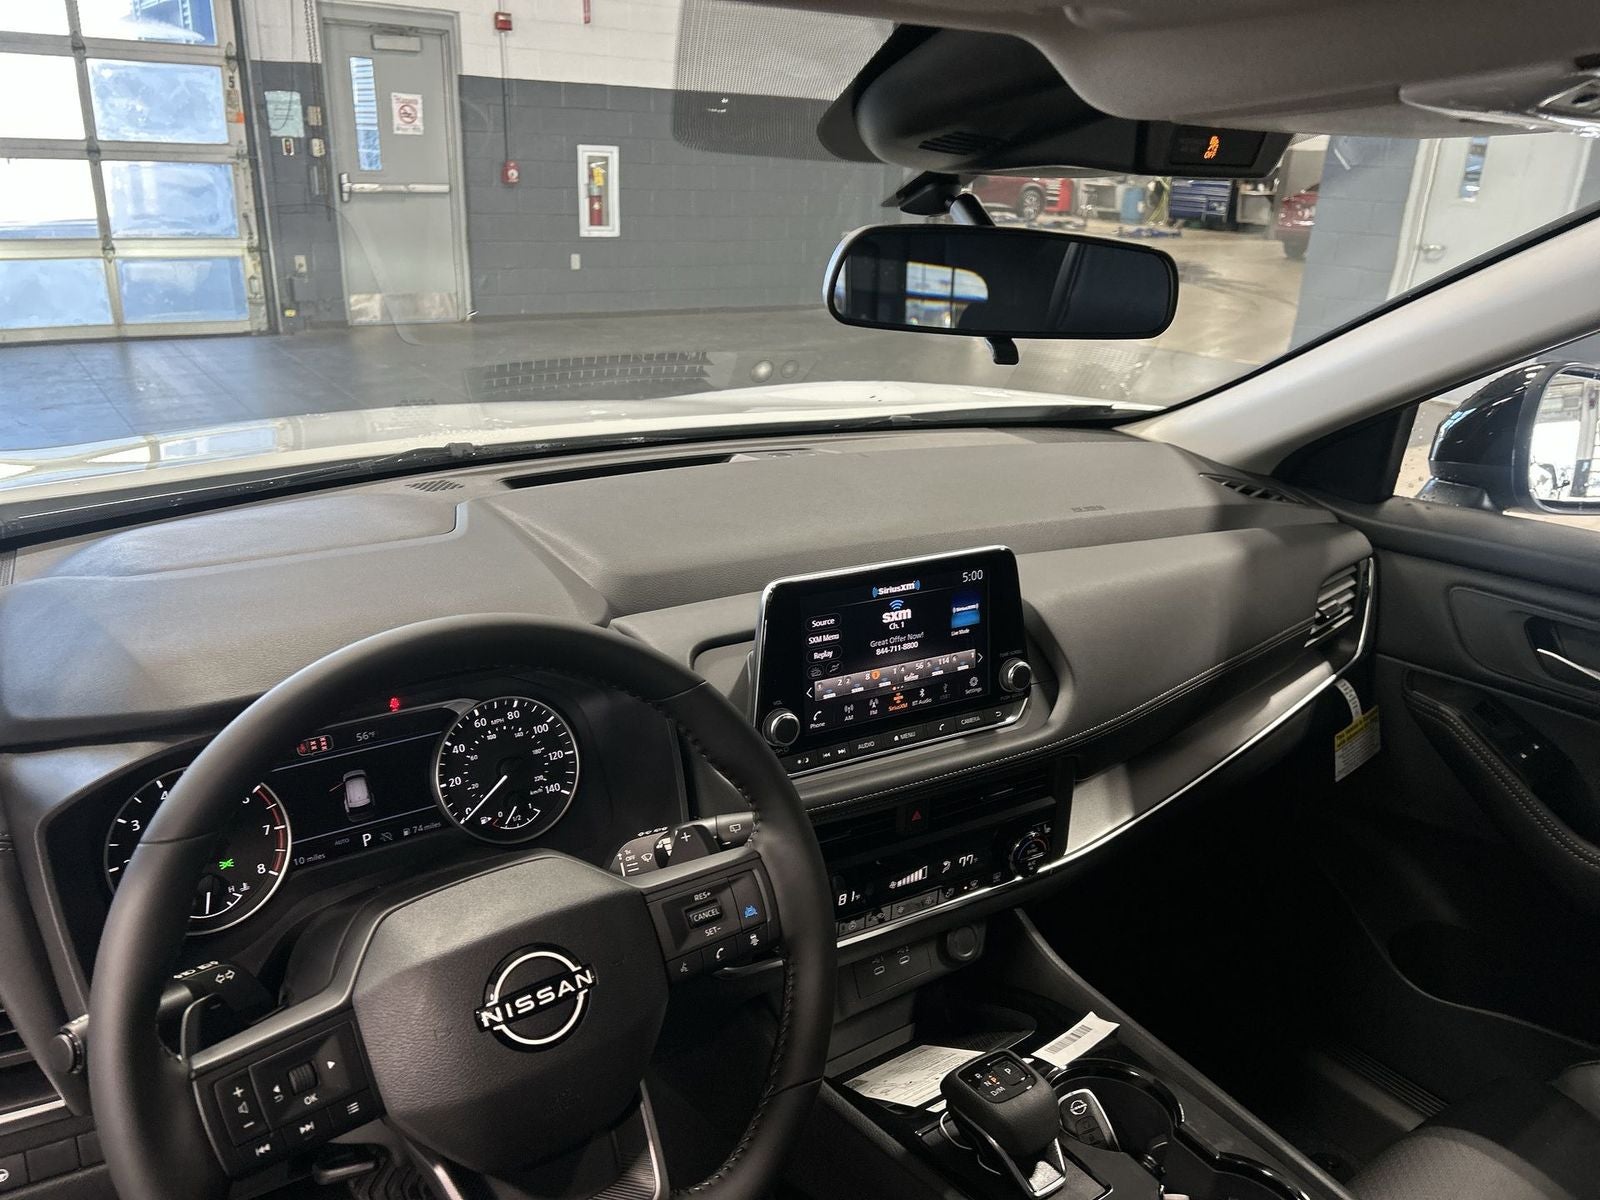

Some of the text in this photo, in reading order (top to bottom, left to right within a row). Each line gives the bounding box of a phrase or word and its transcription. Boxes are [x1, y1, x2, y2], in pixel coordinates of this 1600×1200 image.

[962, 570, 984, 582] 5:00
[811, 618, 835, 628] Source
[822, 633, 840, 643] Menu
[869, 638, 889, 648] Great
[889, 635, 906, 644] Offer
[875, 641, 919, 656] 844-711-8800
[813, 650, 834, 660] Replay
[915, 662, 924, 671] 56
[507, 710, 520, 720] 80
[474, 718, 487, 728] 60
[533, 723, 549, 735] 100
[900, 731, 916, 740] MENU
[452, 744, 466, 754] 40
[858, 741, 875, 749] AUDIO
[548, 750, 563, 761] 120
[448, 776, 461, 787] 20
[545, 783, 561, 794] 140
[131, 820, 141, 831] 3
[262, 825, 270, 836] 7
[362, 833, 372, 847] P
[307, 853, 326, 863] miles
[257, 863, 266, 874] 8
[693, 908, 720, 922] CANCEL
[480, 969, 593, 1028] NISSAN
[304, 1093, 318, 1105] OK
